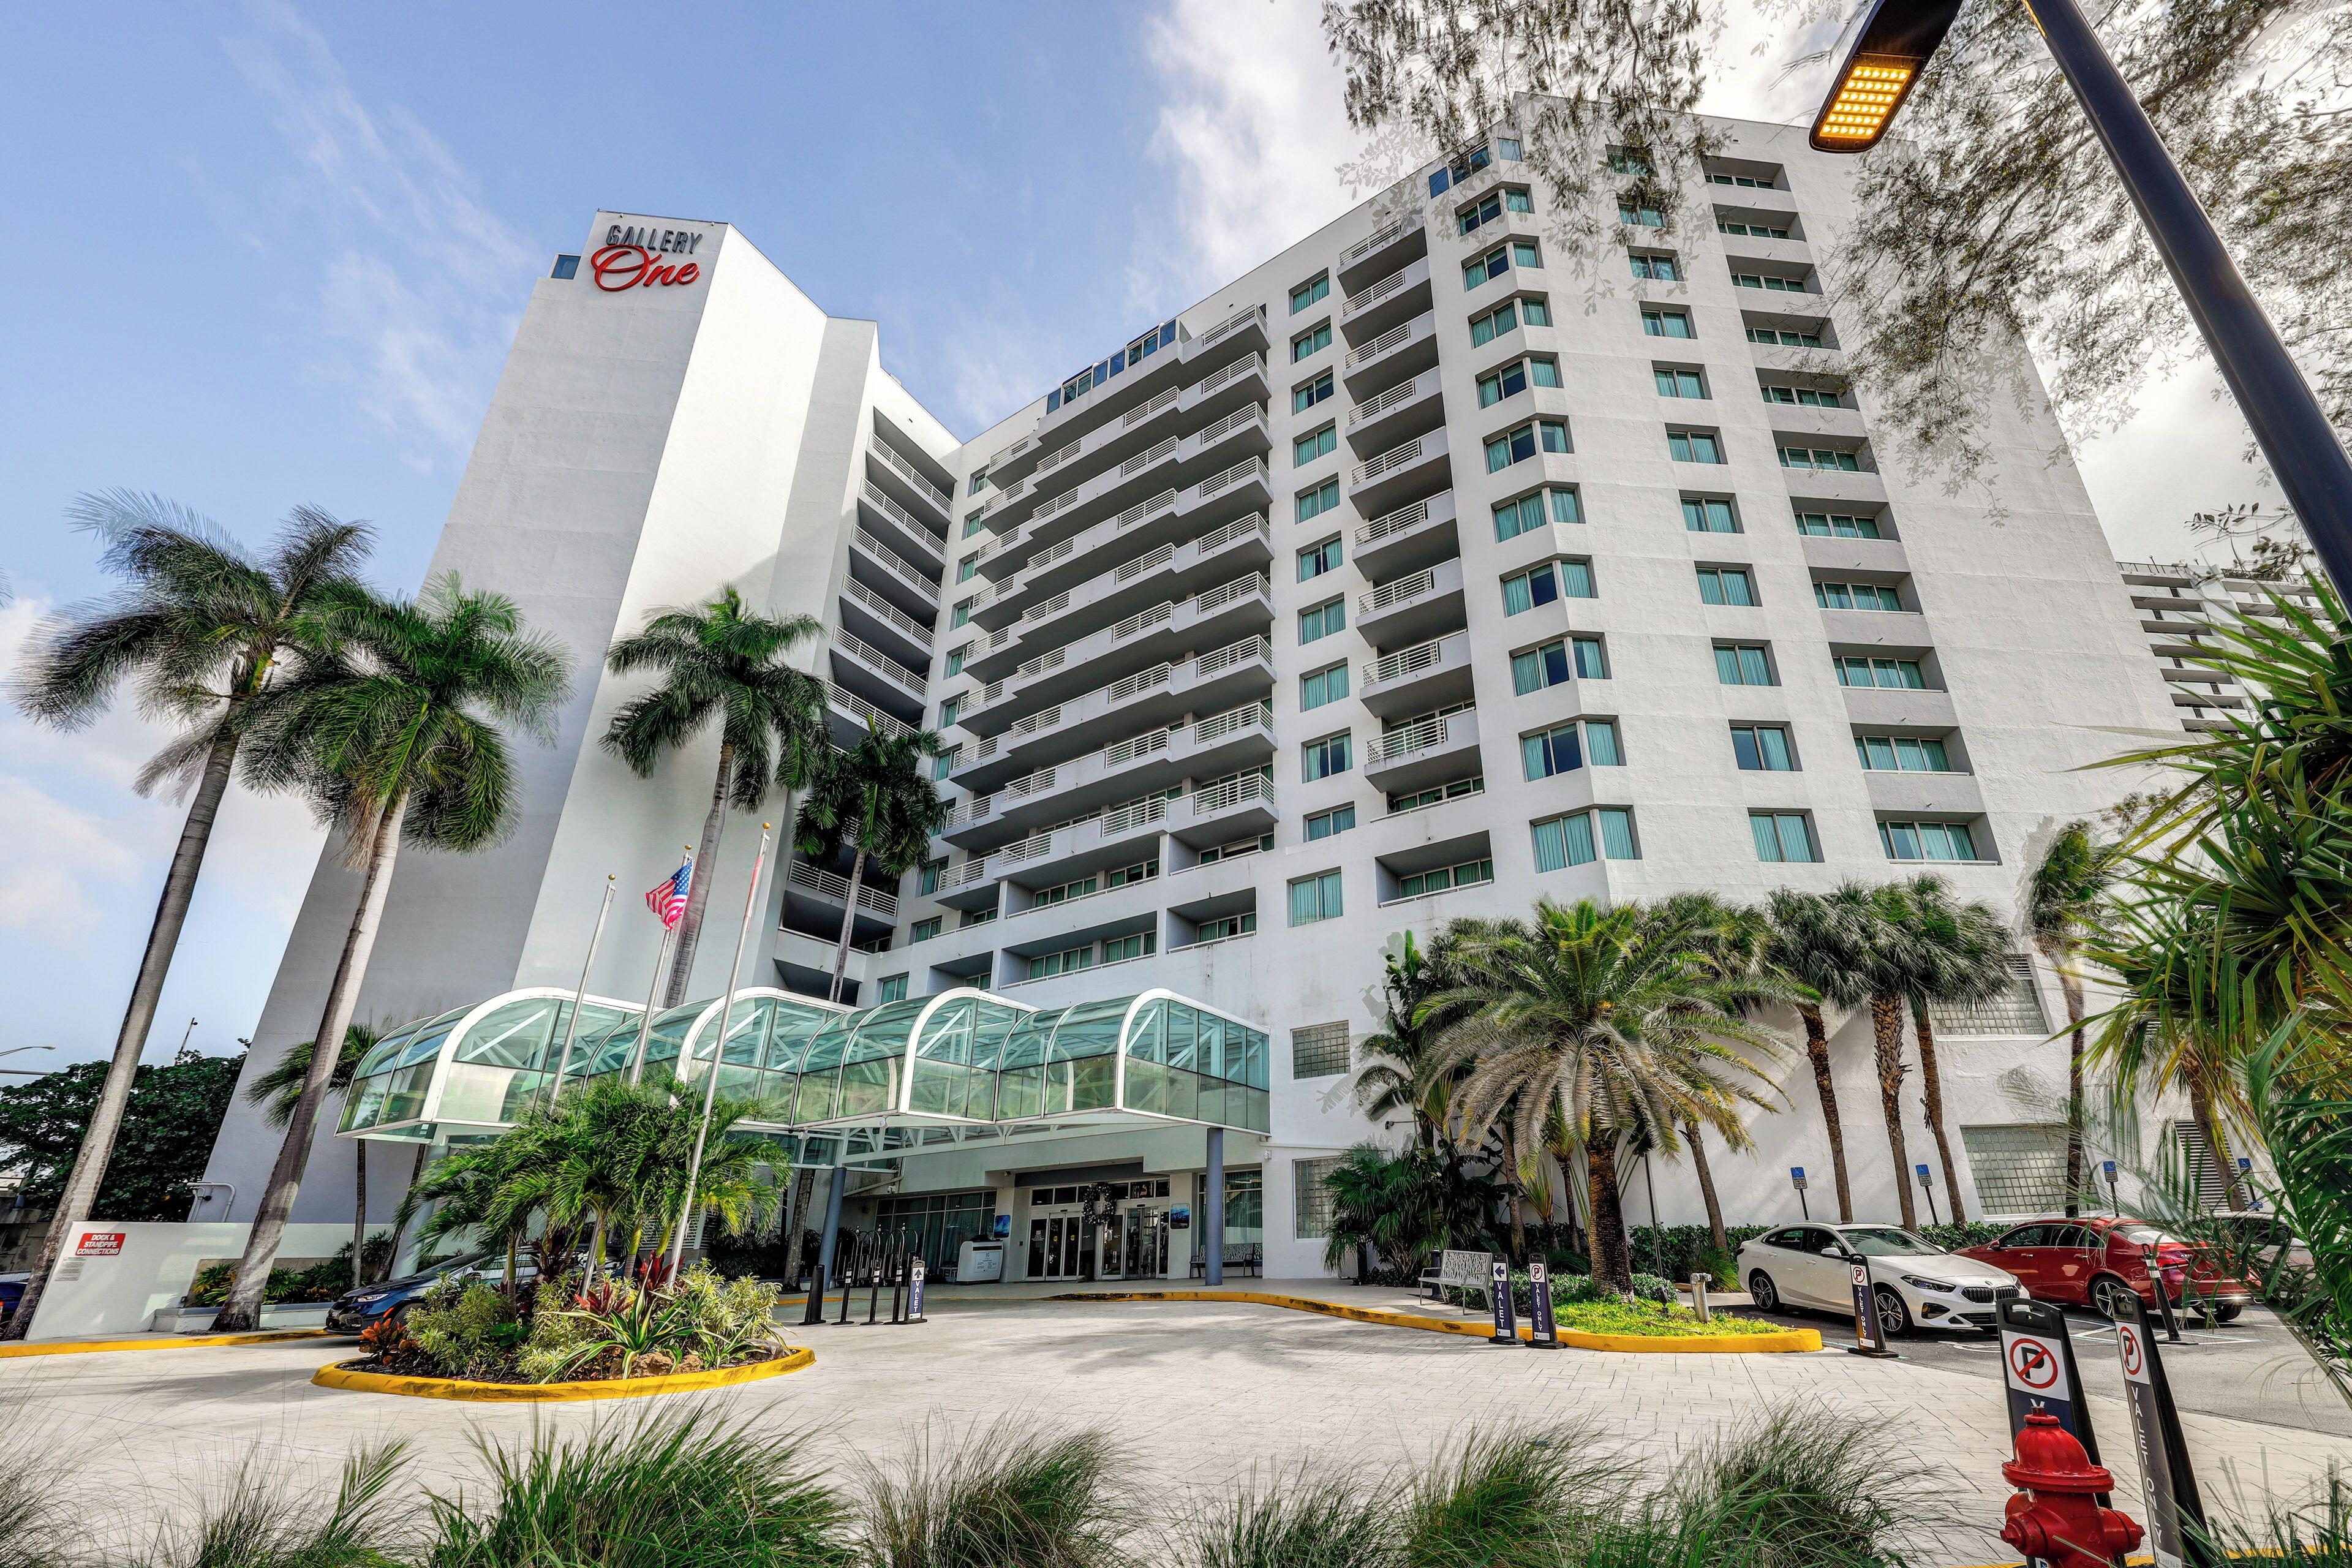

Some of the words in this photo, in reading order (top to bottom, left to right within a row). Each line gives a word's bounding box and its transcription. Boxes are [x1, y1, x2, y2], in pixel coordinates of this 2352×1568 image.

[606, 225, 703, 254] GALLERY
[590, 244, 700, 292] One
[2131, 1386, 2149, 1466] VALET
[2146, 1477, 2162, 1544] ONLY
